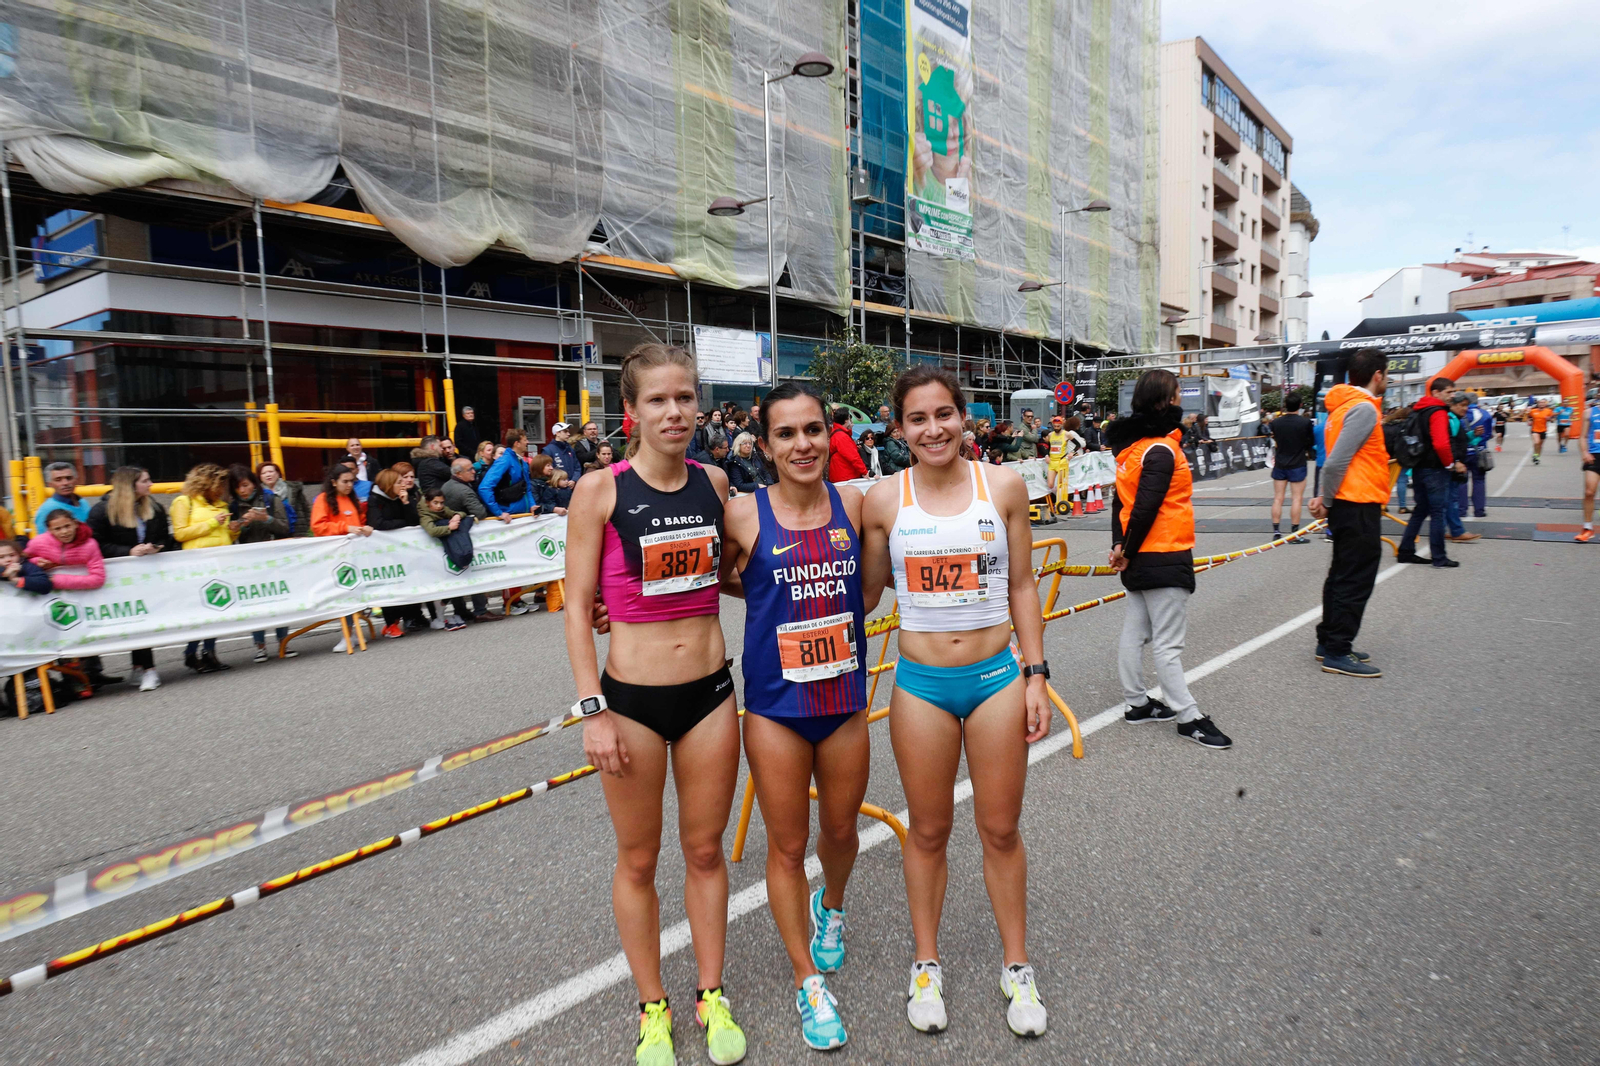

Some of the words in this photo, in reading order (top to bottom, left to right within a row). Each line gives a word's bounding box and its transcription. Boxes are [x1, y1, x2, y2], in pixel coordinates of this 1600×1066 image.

[1339, 336, 1389, 350] Concello
[1390, 335, 1408, 346] do
[1409, 331, 1461, 345] Porriño
[1478, 352, 1524, 364] GADIS
[651, 518, 661, 527] O
[664, 515, 704, 526] BARCO
[653, 534, 675, 543] CARREIRA
[897, 525, 938, 537] hummel
[669, 541, 691, 550] SANDRA
[361, 563, 407, 582] RAMA
[661, 547, 701, 579] 387
[772, 555, 857, 585] FUNDACIÓ
[920, 563, 964, 592] 942
[236, 579, 291, 601] RAMA
[790, 579, 848, 601] BARÇA
[84, 599, 149, 621] RAMA
[788, 623, 811, 631] CARREIRA
[799, 634, 837, 667] 801
[980, 664, 1011, 681] hummel
